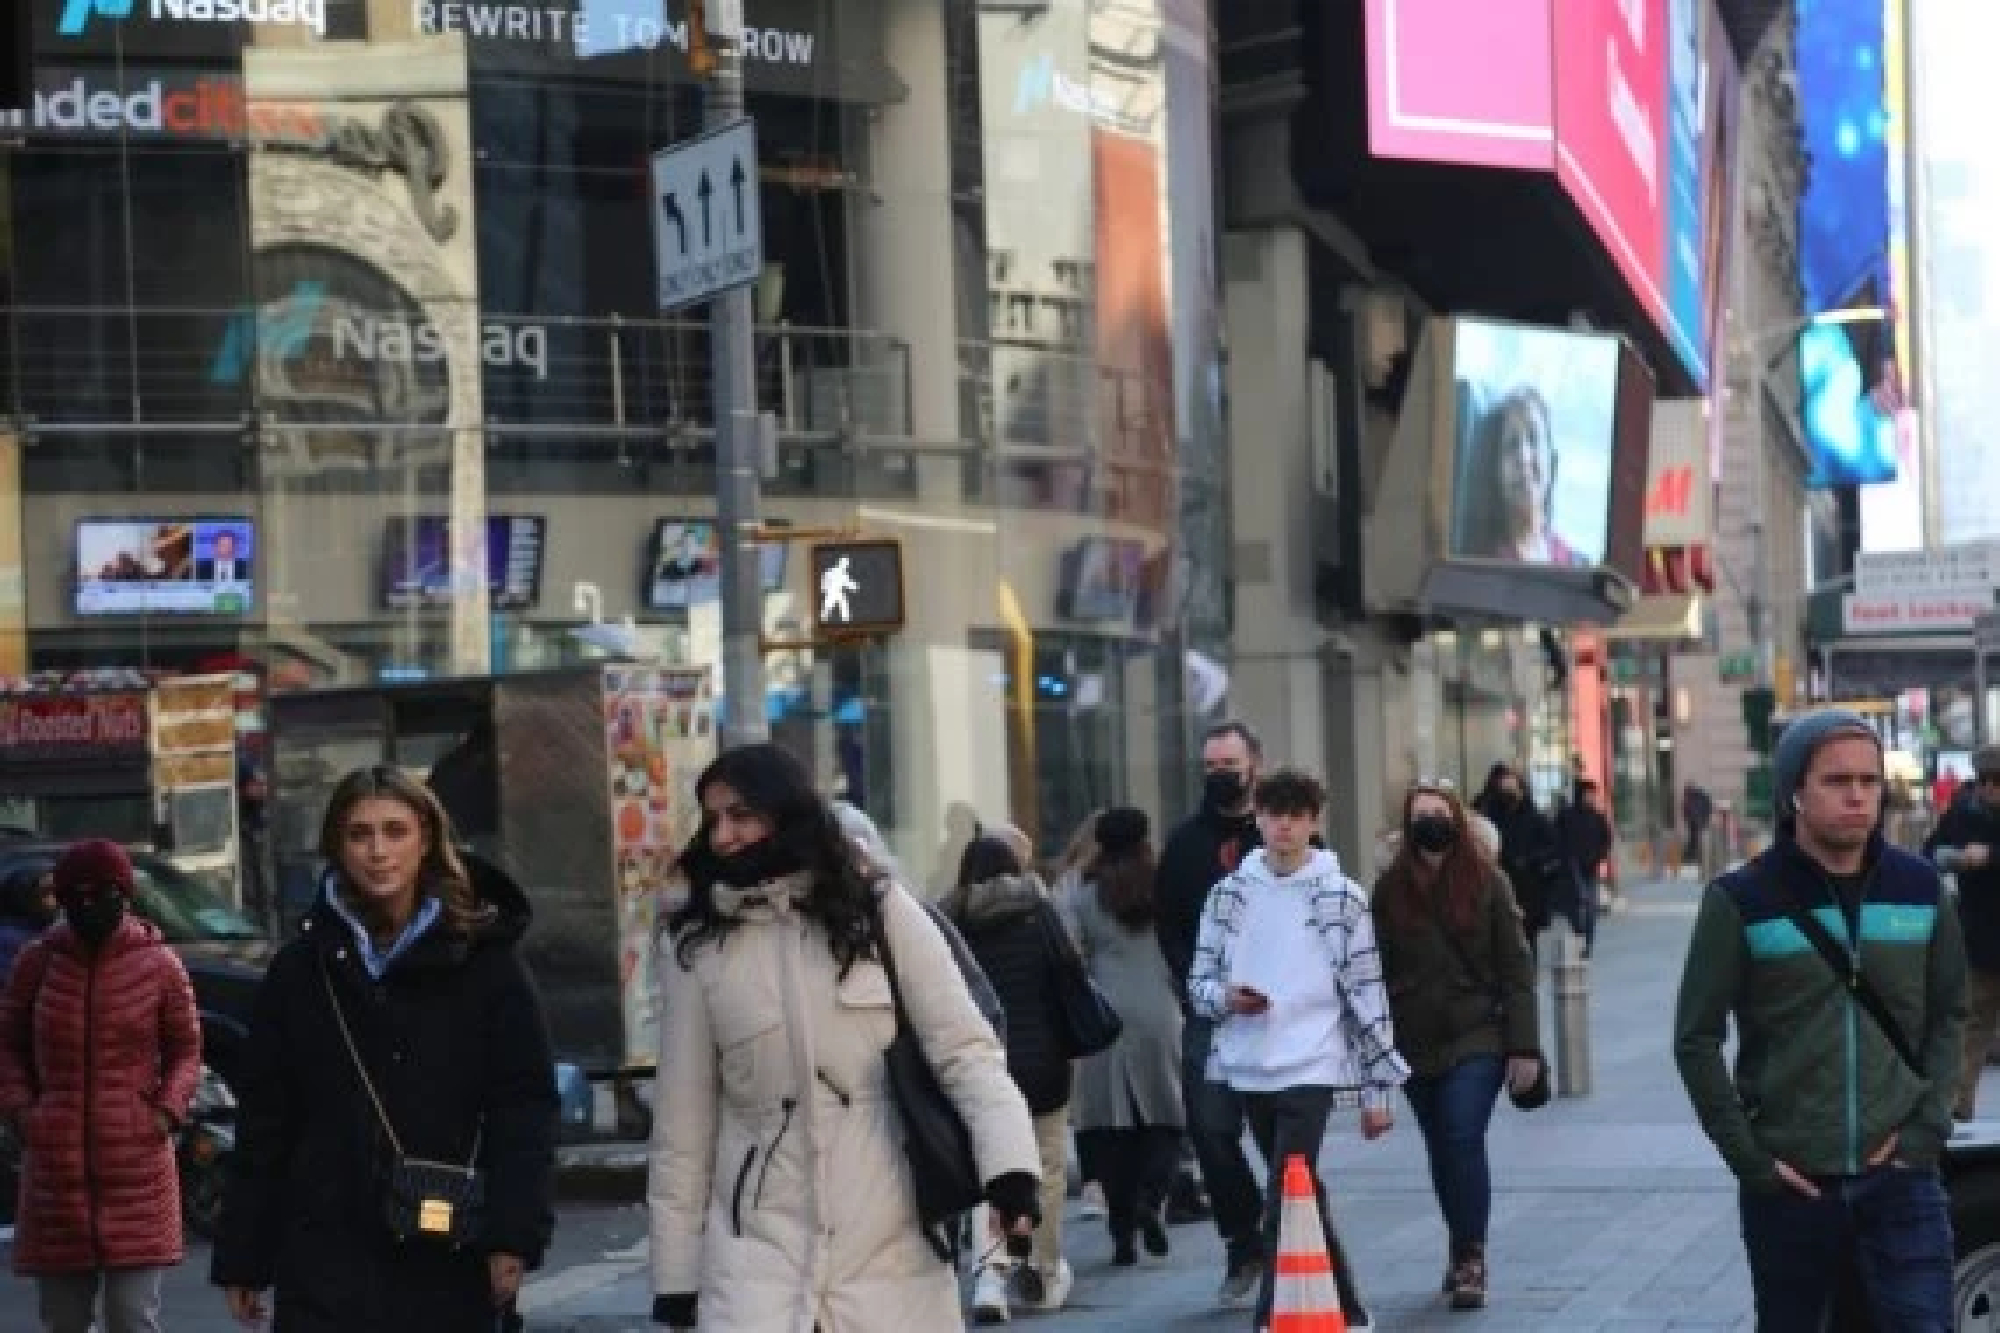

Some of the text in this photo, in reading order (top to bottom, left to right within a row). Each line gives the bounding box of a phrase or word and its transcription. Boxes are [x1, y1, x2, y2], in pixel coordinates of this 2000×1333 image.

[149, 0, 327, 34] Nasdaq
[412, 1, 815, 65] REWRITE TOMROW
[332, 309, 548, 380] Nasaq
